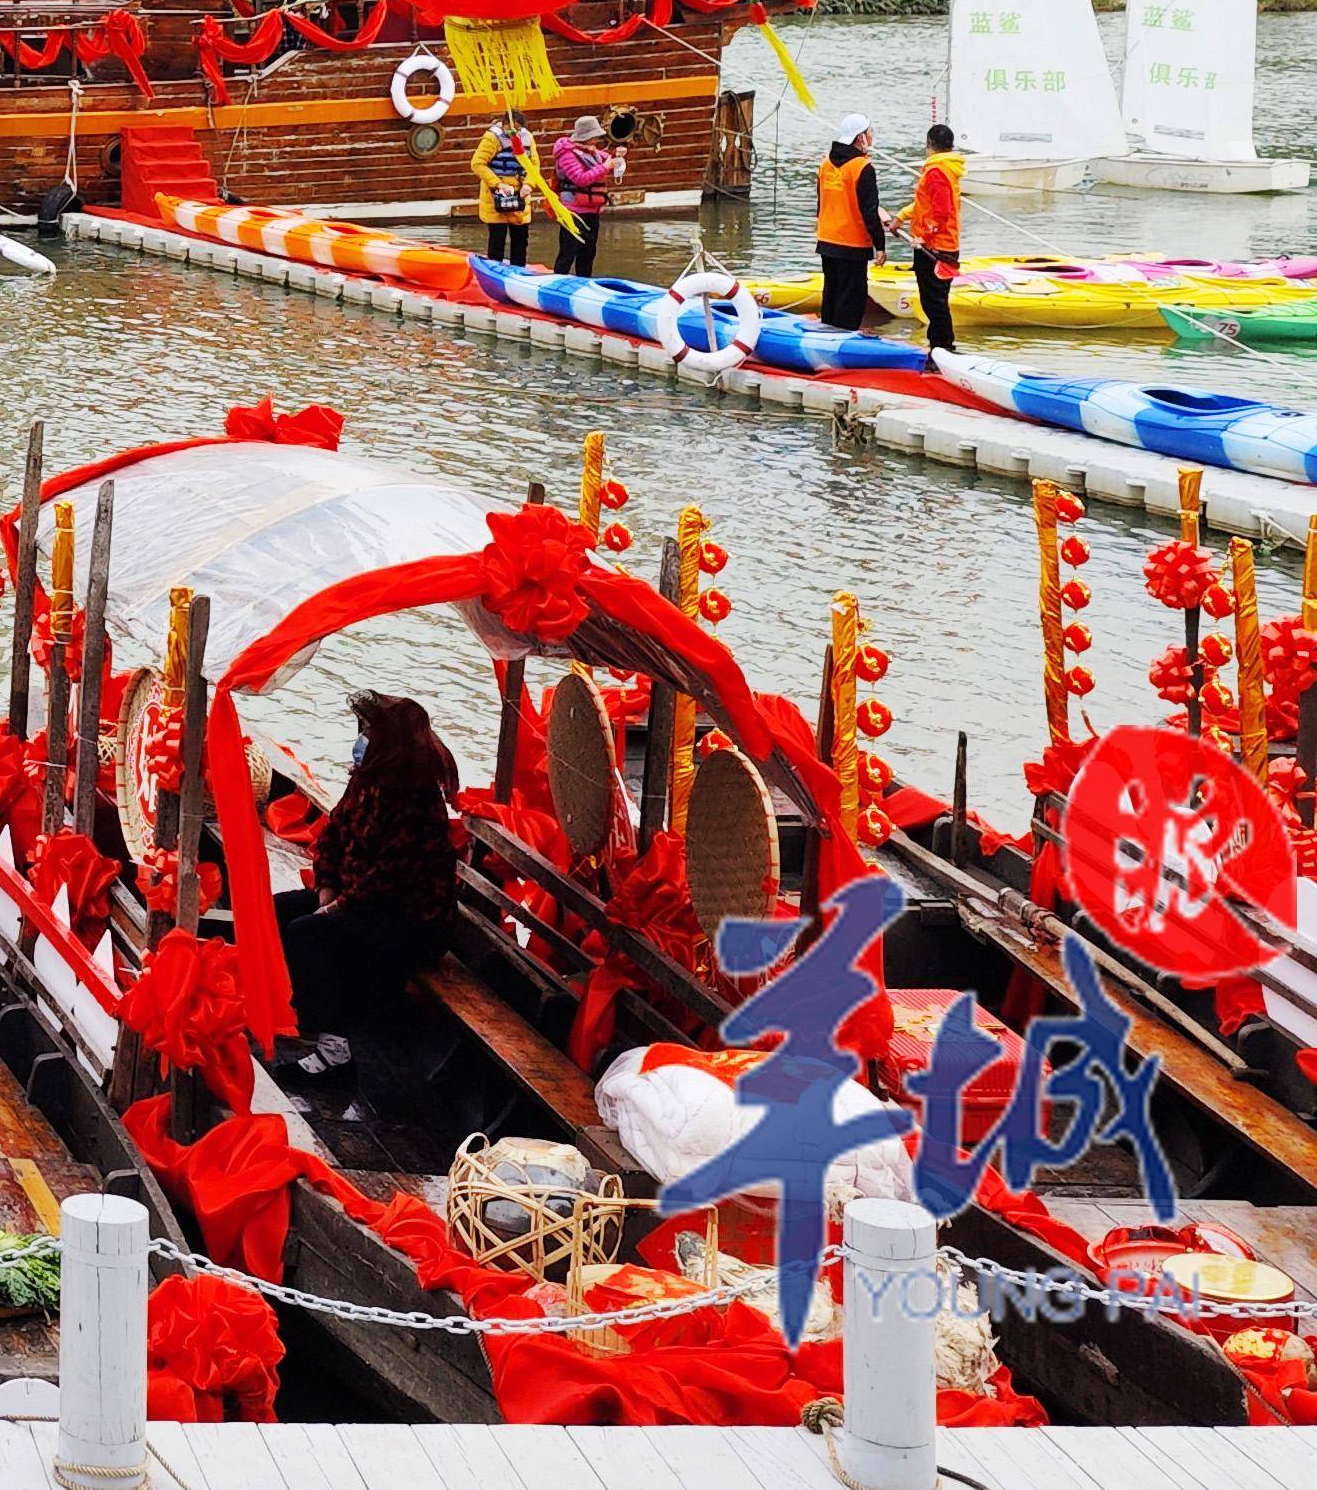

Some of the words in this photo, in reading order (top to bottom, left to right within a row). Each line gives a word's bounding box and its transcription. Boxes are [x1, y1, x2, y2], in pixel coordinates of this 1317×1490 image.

[969, 11, 1023, 35] 蓝鲨
[1142, 5, 1196, 32] 蓝鲨
[984, 69, 1067, 93] 俱乐部
[1218, 323, 1239, 337] 75
